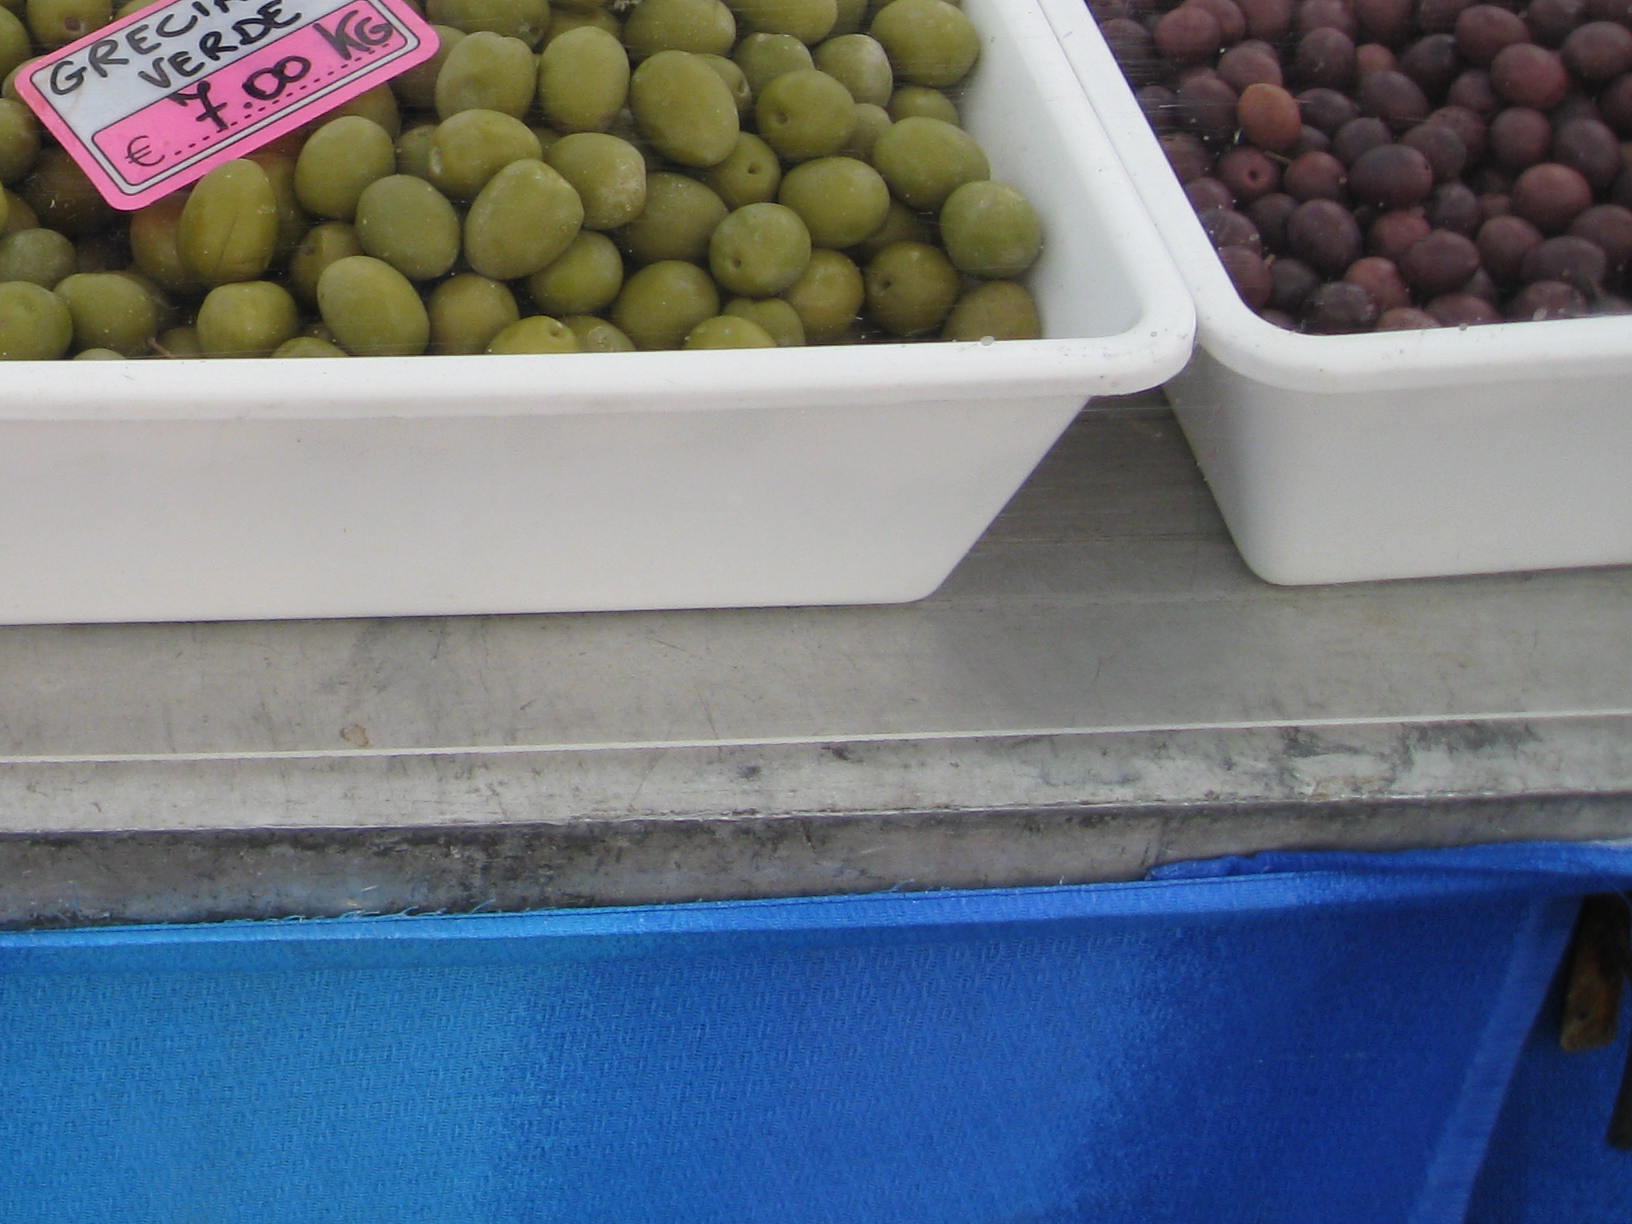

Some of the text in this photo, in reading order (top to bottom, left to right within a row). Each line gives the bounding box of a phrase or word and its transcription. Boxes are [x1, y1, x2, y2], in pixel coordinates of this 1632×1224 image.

[126, 9, 395, 167] € 7.00 KG
